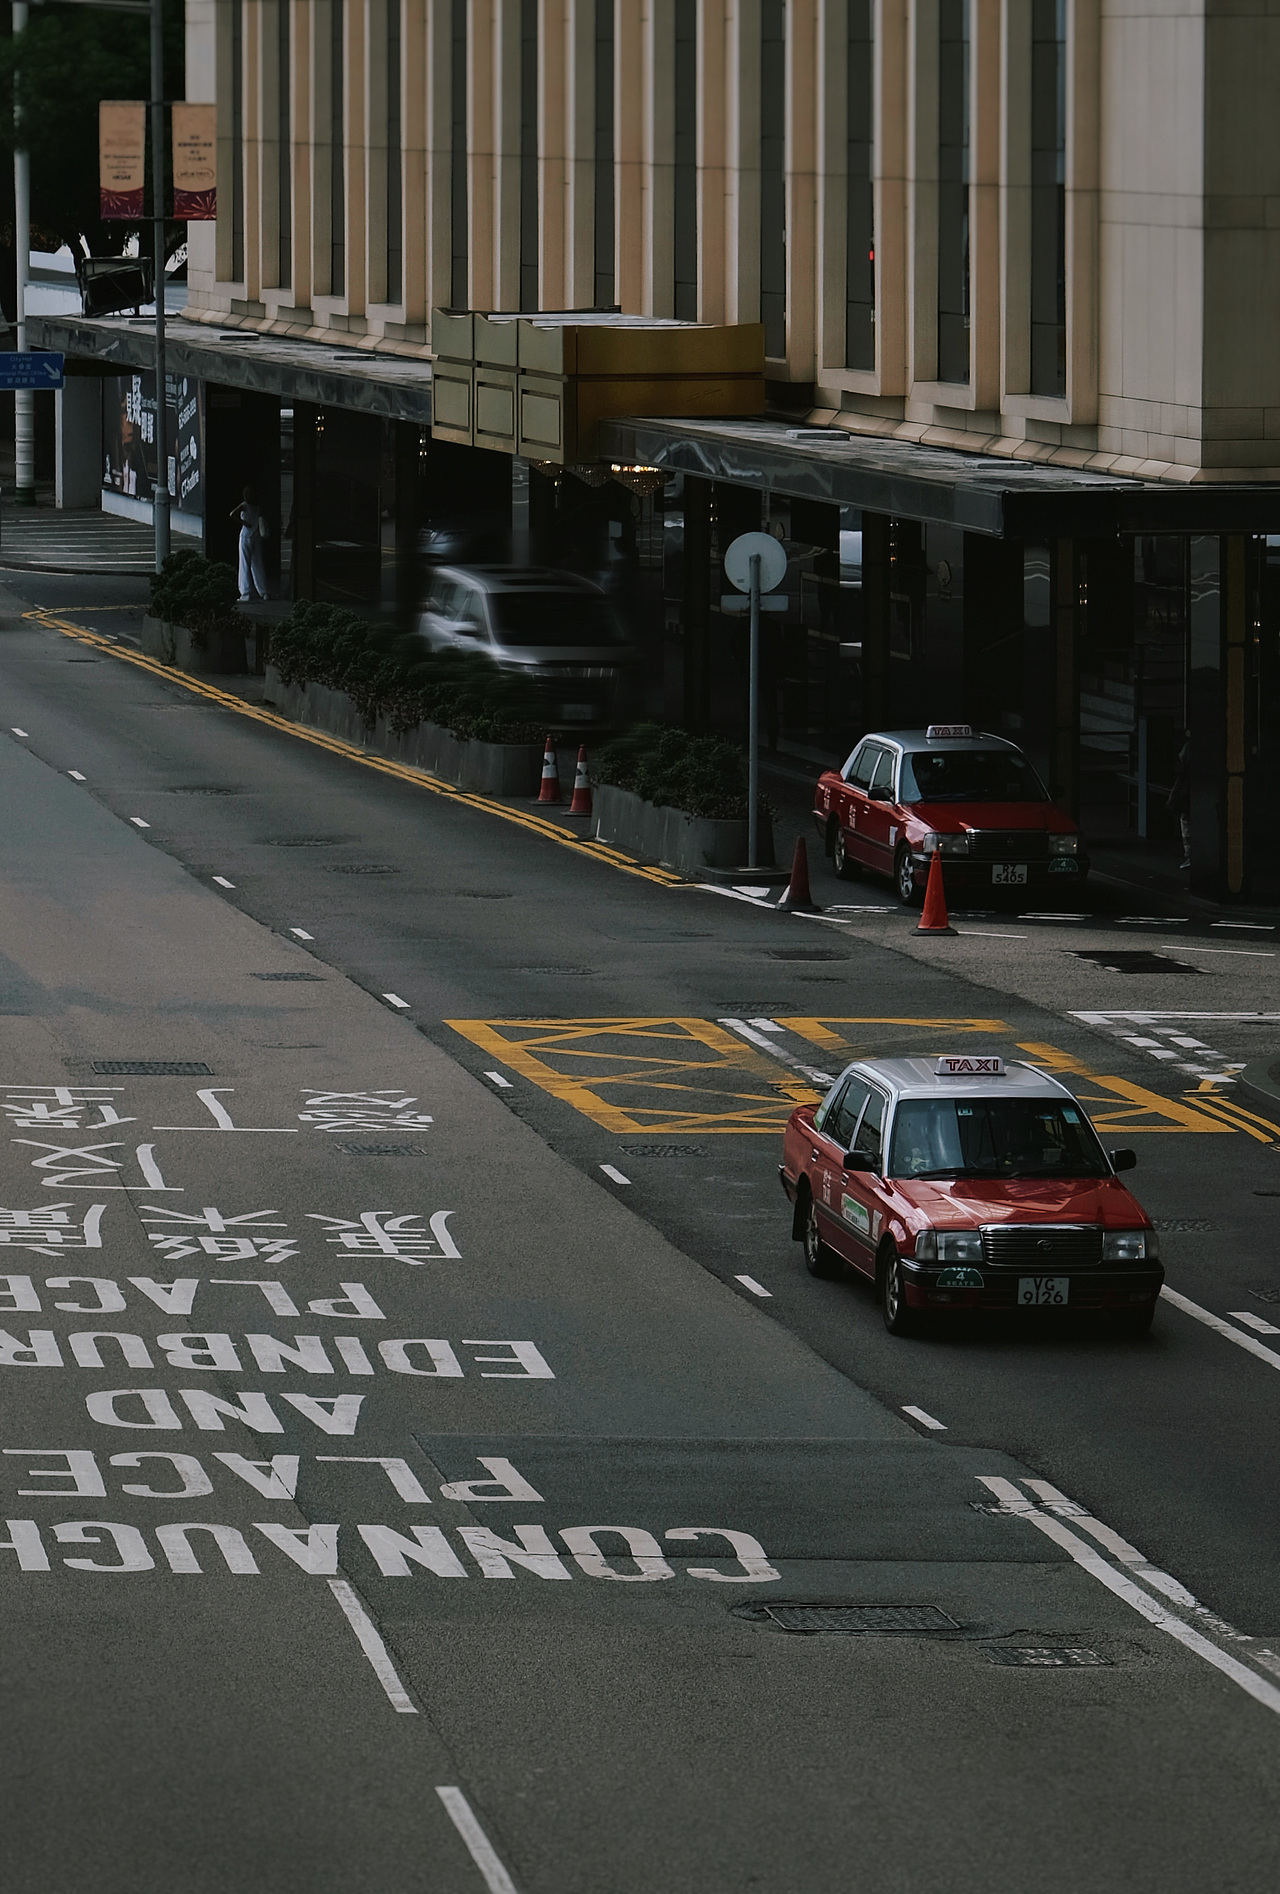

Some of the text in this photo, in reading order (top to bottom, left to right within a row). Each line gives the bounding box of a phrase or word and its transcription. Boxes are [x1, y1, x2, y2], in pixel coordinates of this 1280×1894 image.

[933, 727, 970, 736] TAXI
[1003, 865, 1017, 873] RZ
[995, 873, 1025, 883] 5405
[946, 1059, 1000, 1072] TAXI
[0, 1086, 435, 1132] 愛丁堡
[10, 1139, 185, 1191] 及
[955, 1272, 965, 1280] 4
[1033, 1278, 1055, 1291] VG
[1023, 1291, 1064, 1304] 9126
[0, 1329, 556, 1379] EDINBUR
[85, 1389, 366, 1435] AND
[1, 1450, 545, 1503] PLACE
